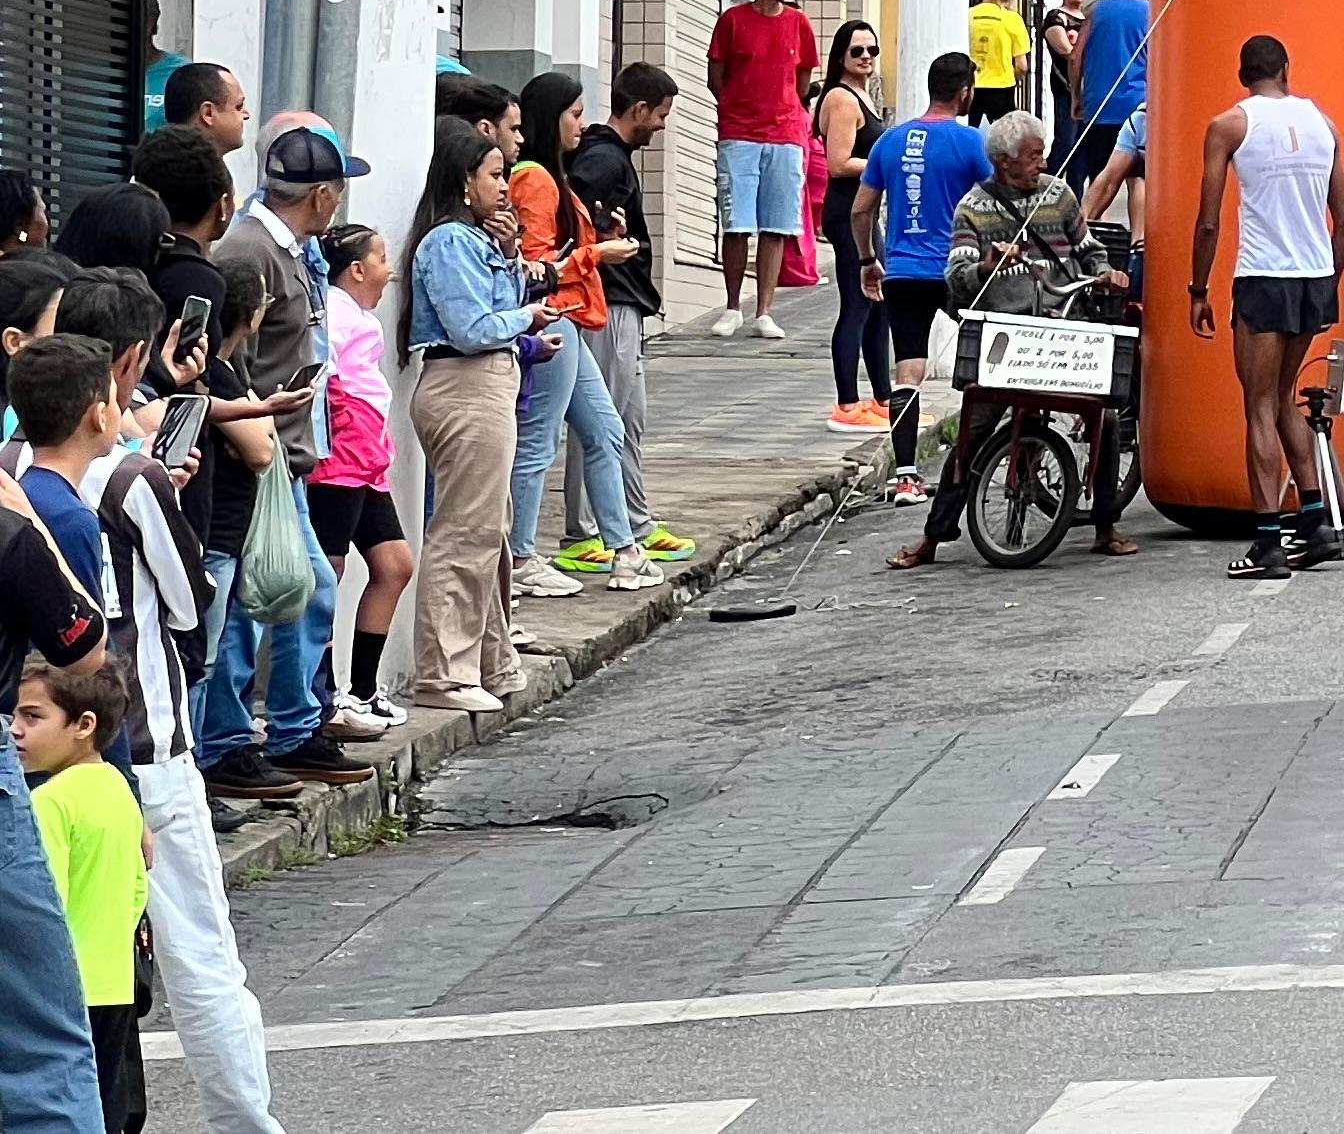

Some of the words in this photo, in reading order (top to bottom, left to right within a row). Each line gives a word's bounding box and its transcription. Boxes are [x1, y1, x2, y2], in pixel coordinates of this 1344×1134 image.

[1015, 328, 1046, 340] PICOLÉ
[1058, 332, 1077, 342] POR
[1048, 349, 1067, 357] POR
[1007, 359, 1035, 368] FIADO
[1050, 362, 1068, 370] EM
